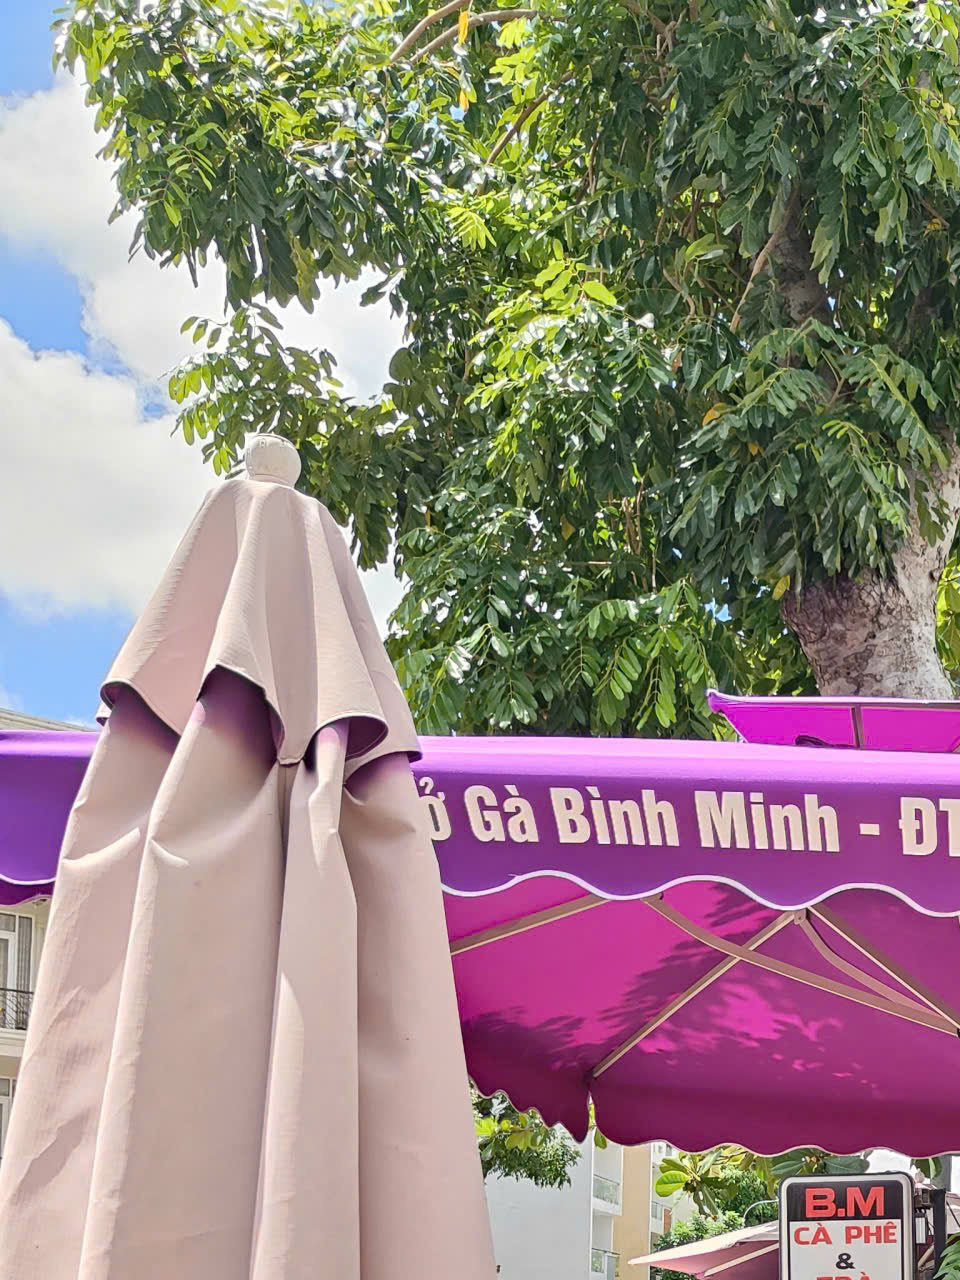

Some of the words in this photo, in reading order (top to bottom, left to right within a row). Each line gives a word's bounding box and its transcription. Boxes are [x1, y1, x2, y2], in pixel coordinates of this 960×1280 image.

[464, 784, 539, 843] Gà
[549, 786, 680, 847] Bình
[694, 790, 840, 853] Minh
[859, 822, 881, 836] -
[805, 1186, 885, 1218] B.M
[793, 1222, 833, 1246] CÀ
[845, 1221, 897, 1245] PHÊ
[835, 1252, 855, 1270] &
